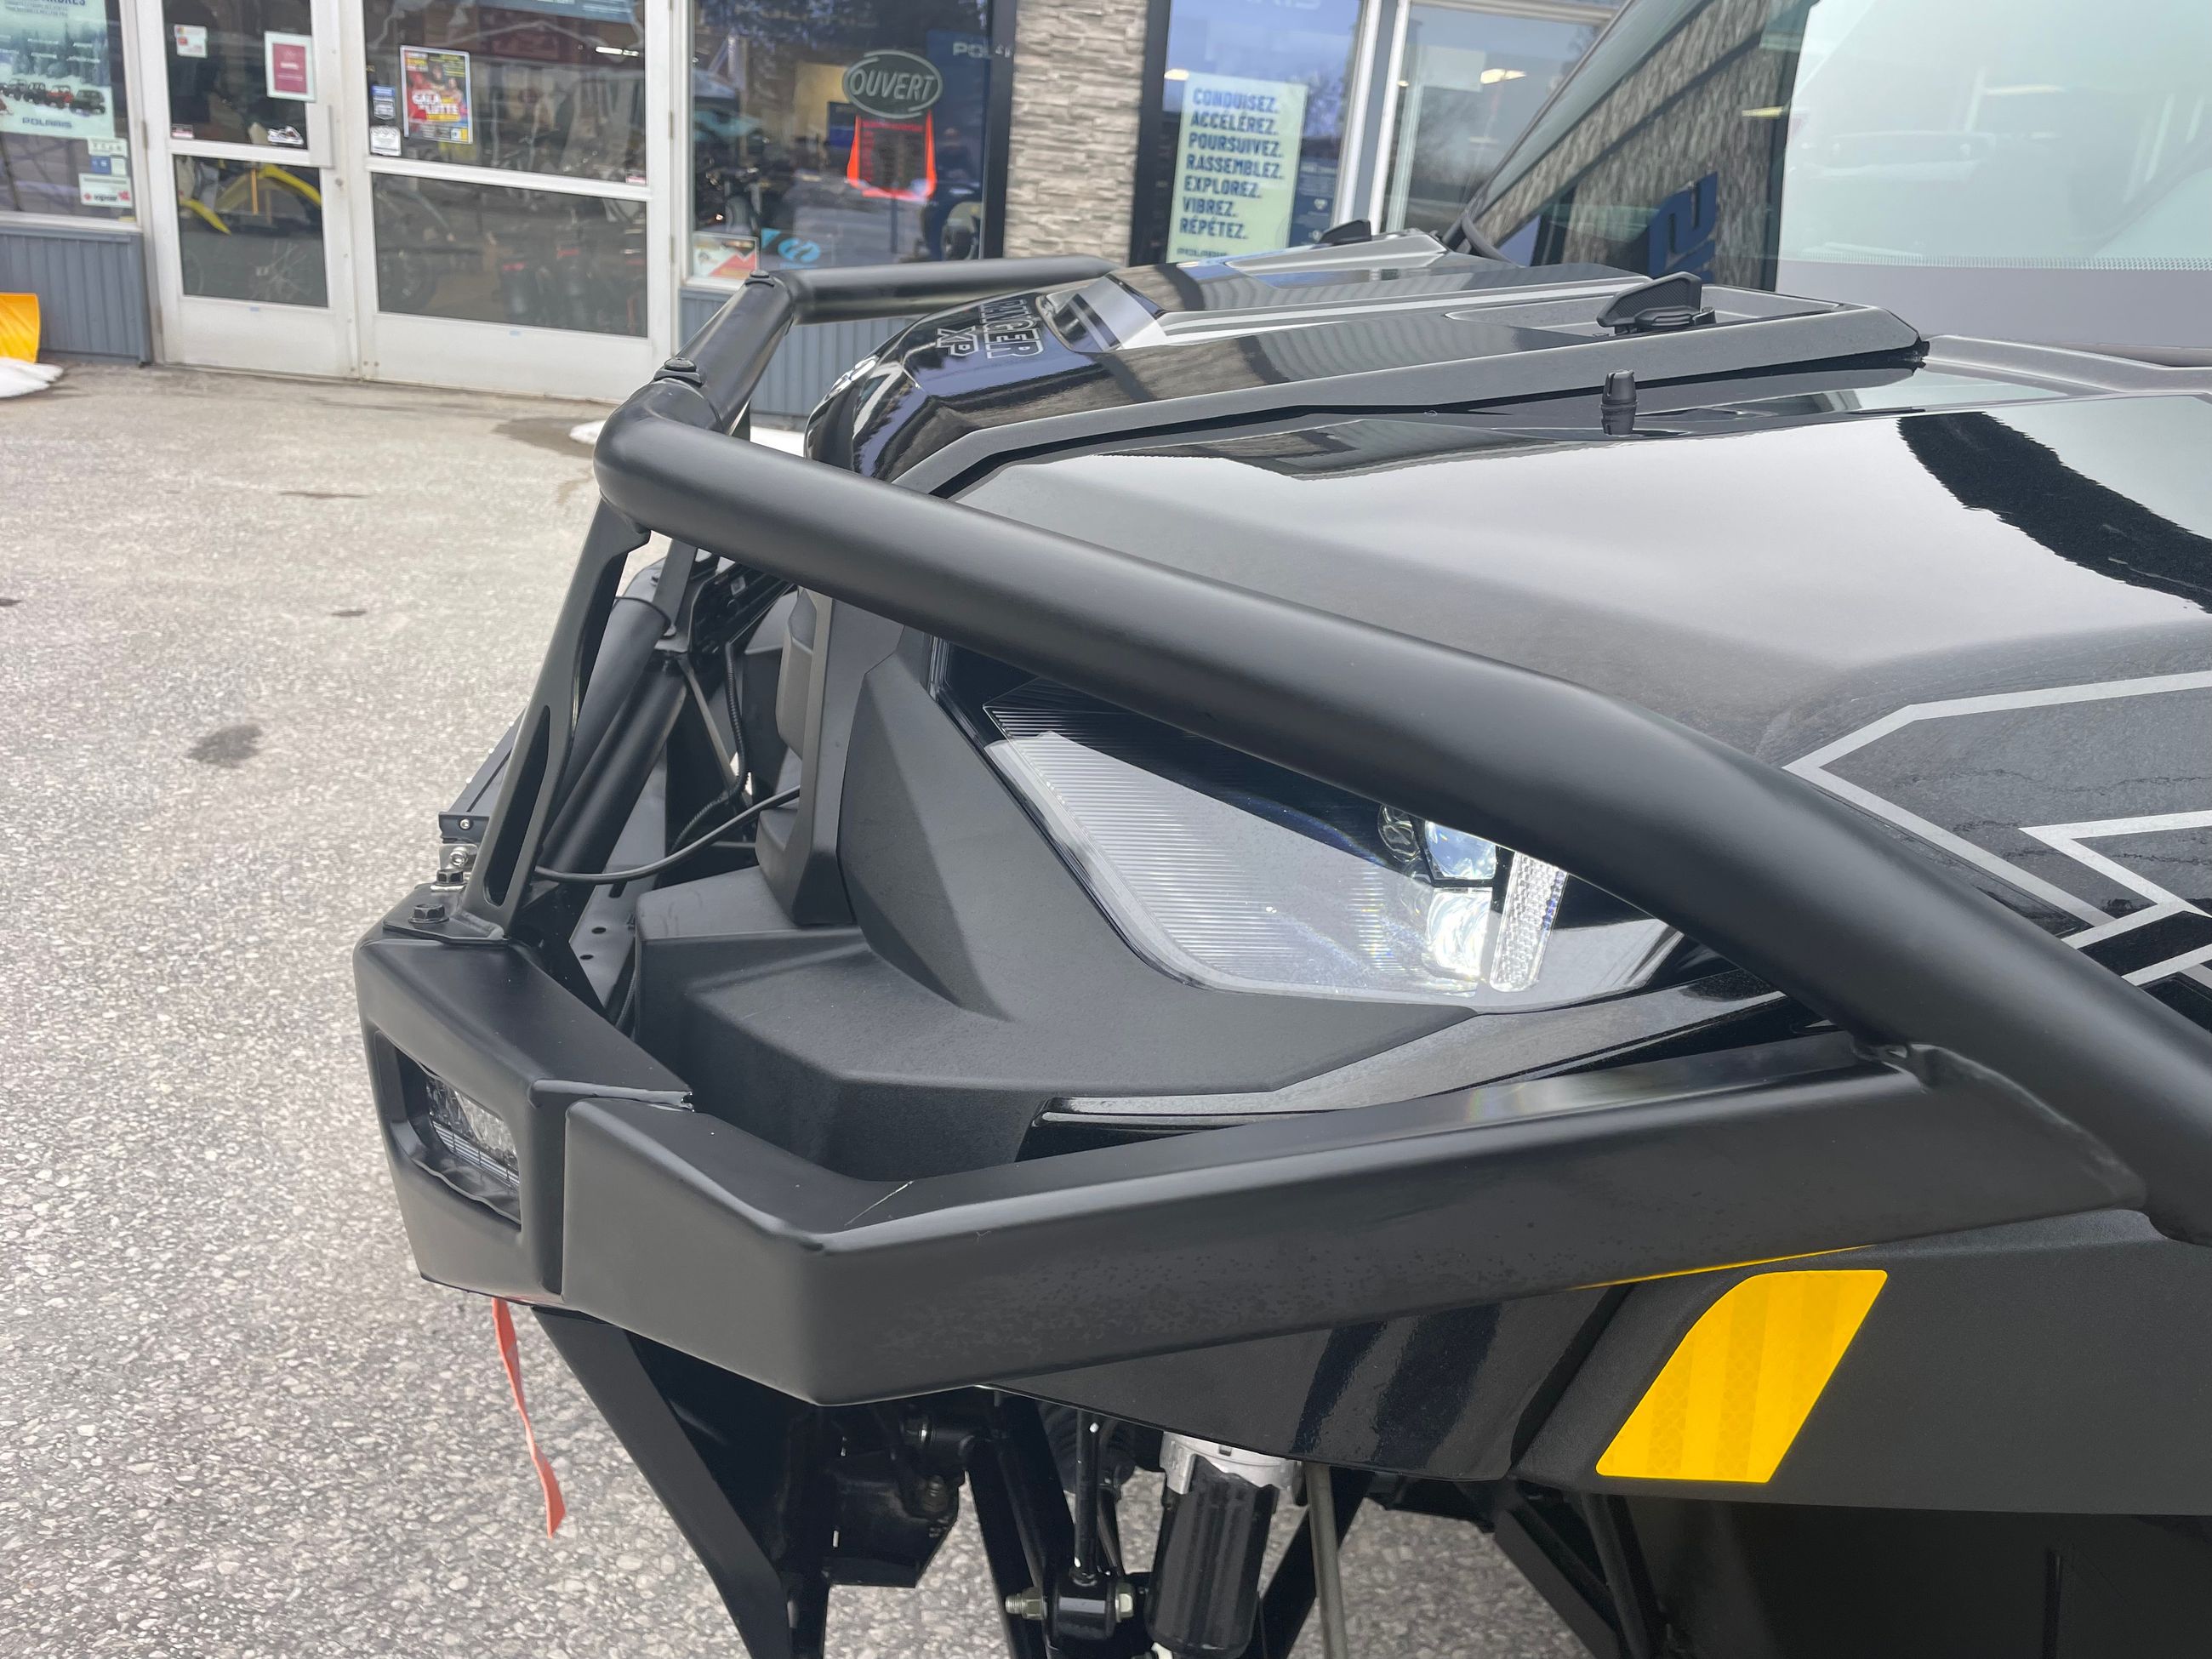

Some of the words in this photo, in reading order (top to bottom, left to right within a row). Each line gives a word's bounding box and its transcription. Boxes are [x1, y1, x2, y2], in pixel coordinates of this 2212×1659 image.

[851, 68, 935, 101] OUVERT
[1194, 88, 1280, 113] CONDUISEZ.
[22, 117, 72, 128] POLARIS
[1191, 111, 1278, 134] ACCÉLÉREZ.
[1189, 133, 1283, 157] POURSUIVEZ.
[1187, 154, 1284, 179] RASSEMBLEZ.
[1184, 176, 1262, 198] EXPLOREZ.
[1183, 197, 1237, 217] VIBREZ.
[1180, 215, 1247, 239] RÉPÉTEZ.
[936, 325, 979, 356] XP
[980, 299, 1044, 358] RANGER
